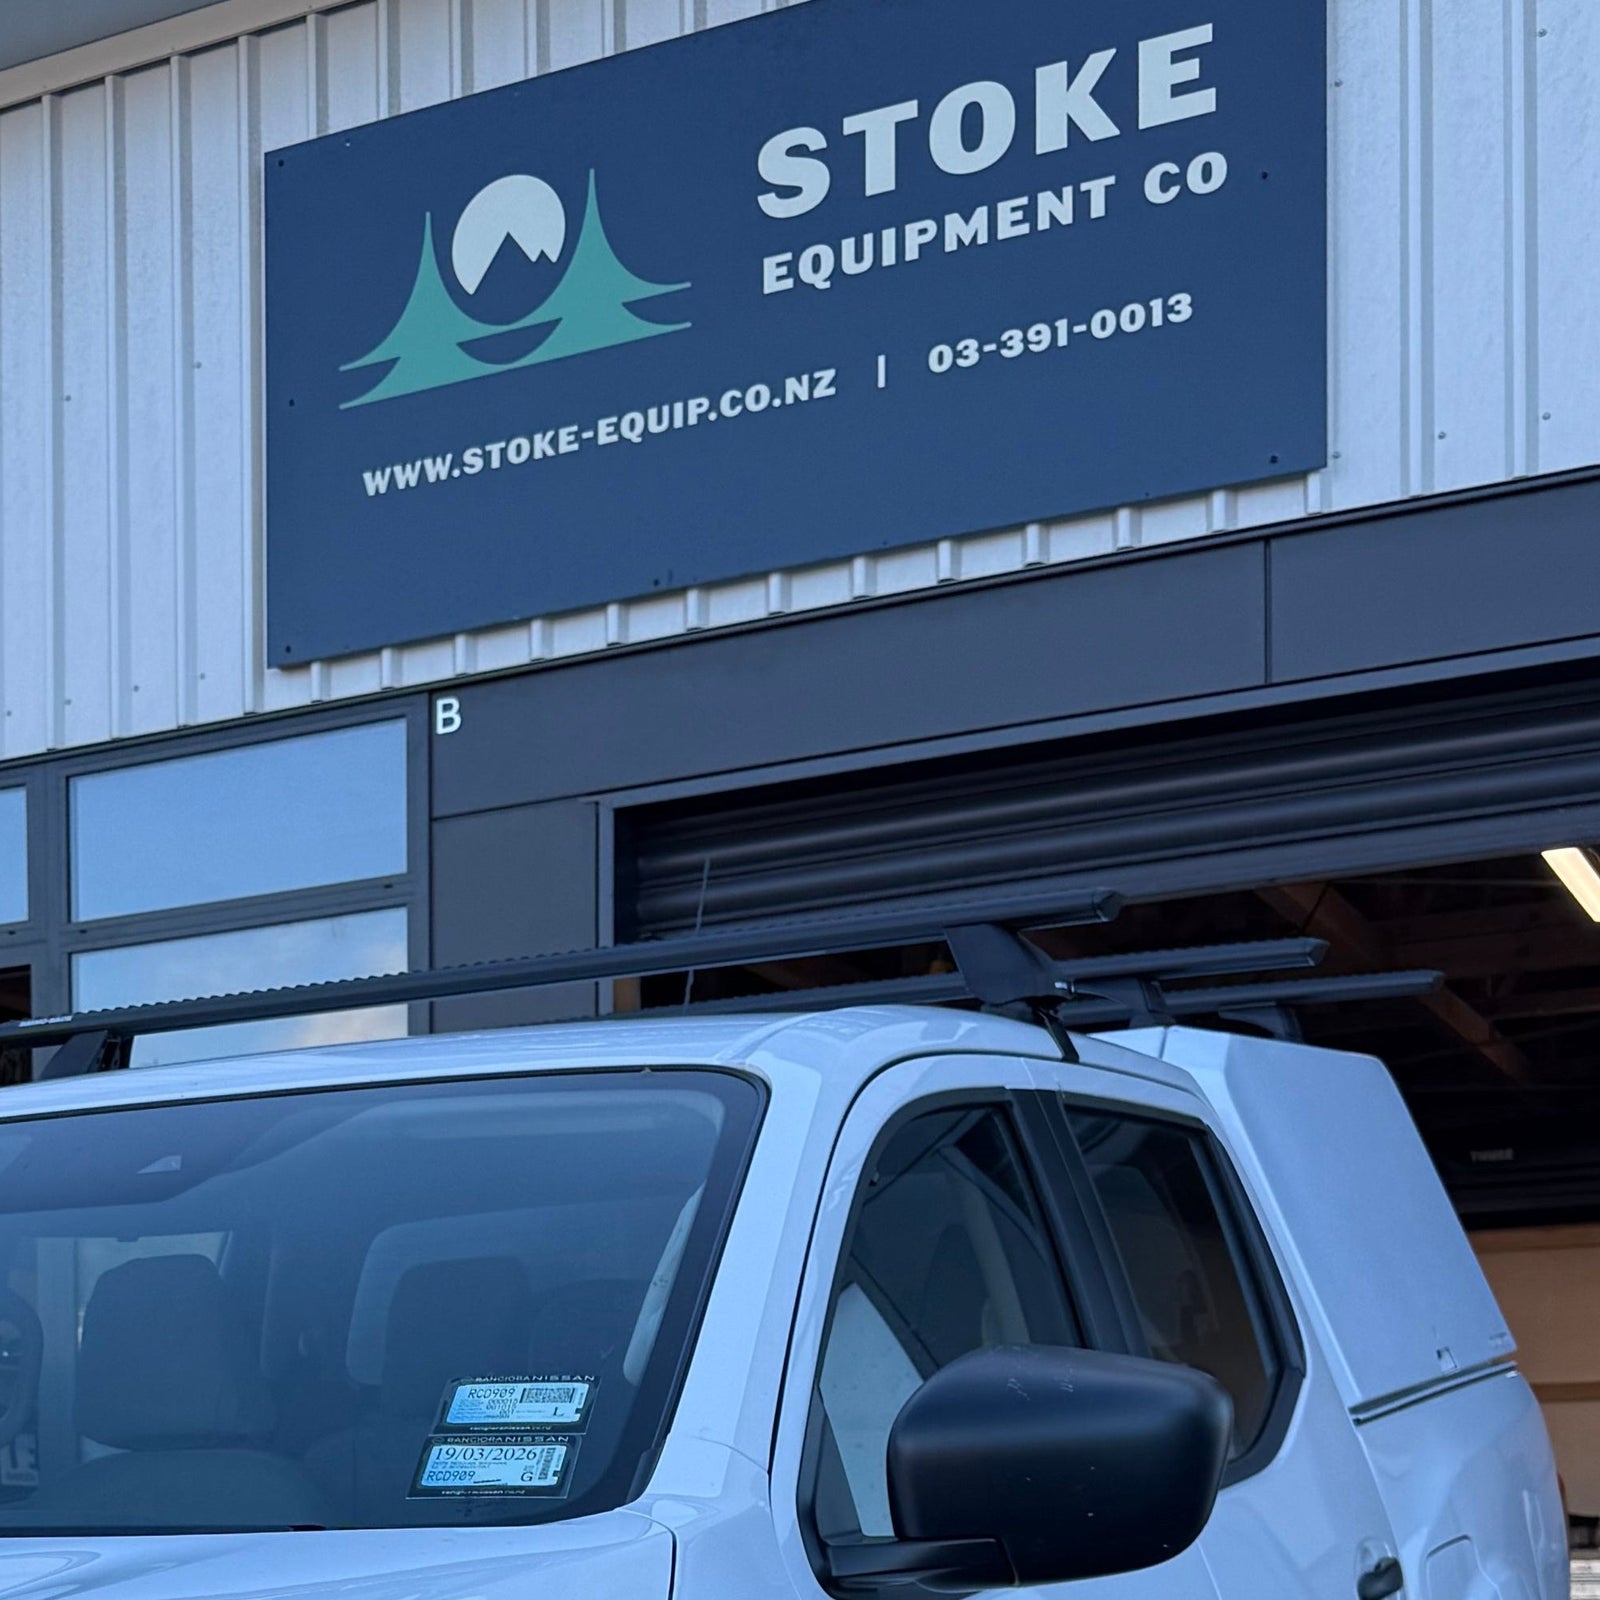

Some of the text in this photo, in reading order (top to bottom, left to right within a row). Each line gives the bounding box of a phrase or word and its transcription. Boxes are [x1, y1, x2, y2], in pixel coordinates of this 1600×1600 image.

[758, 23, 1216, 218] STOKE
[763, 151, 1228, 294] EQUIPMENT CO
[363, 368, 836, 496] WWW.STOKE-EQUIP.CO.NZ
[927, 293, 1193, 373] 03-391-0013
[435, 697, 462, 735] B
[467, 1387, 516, 1399] RCD909
[434, 1447, 538, 1461] 19/03/2026
[426, 1470, 476, 1482] RCD909
[520, 1471, 534, 1482] G
